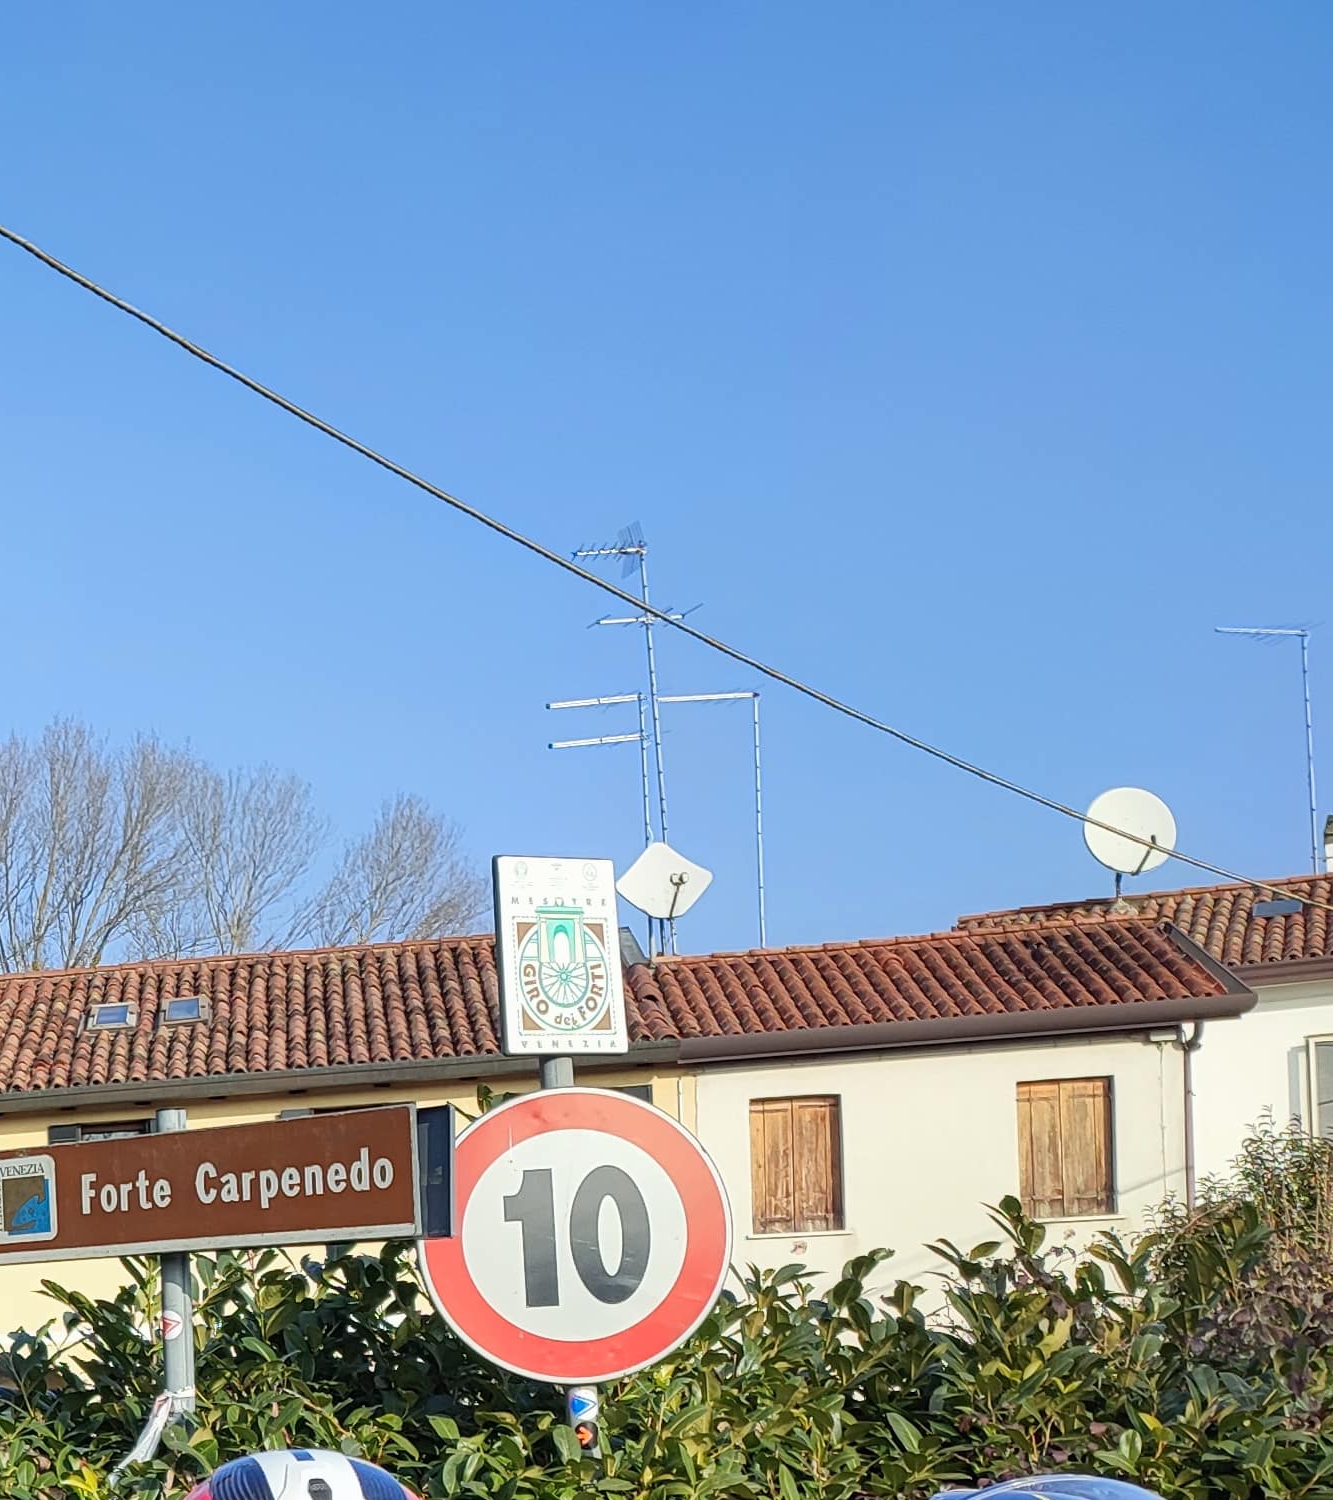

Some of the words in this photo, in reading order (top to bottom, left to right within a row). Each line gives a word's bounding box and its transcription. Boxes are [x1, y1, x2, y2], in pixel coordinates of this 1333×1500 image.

[511, 896, 606, 906] MESTRE
[523, 963, 549, 1015] GIRO
[554, 1012, 579, 1026] dei
[577, 963, 604, 1022] FORTI
[521, 1040, 617, 1048] VENEZIA
[0, 1163, 45, 1177] VENEZIA
[81, 1169, 172, 1215] Forte
[195, 1147, 394, 1209] Carpenedo
[503, 1164, 651, 1307] 10
